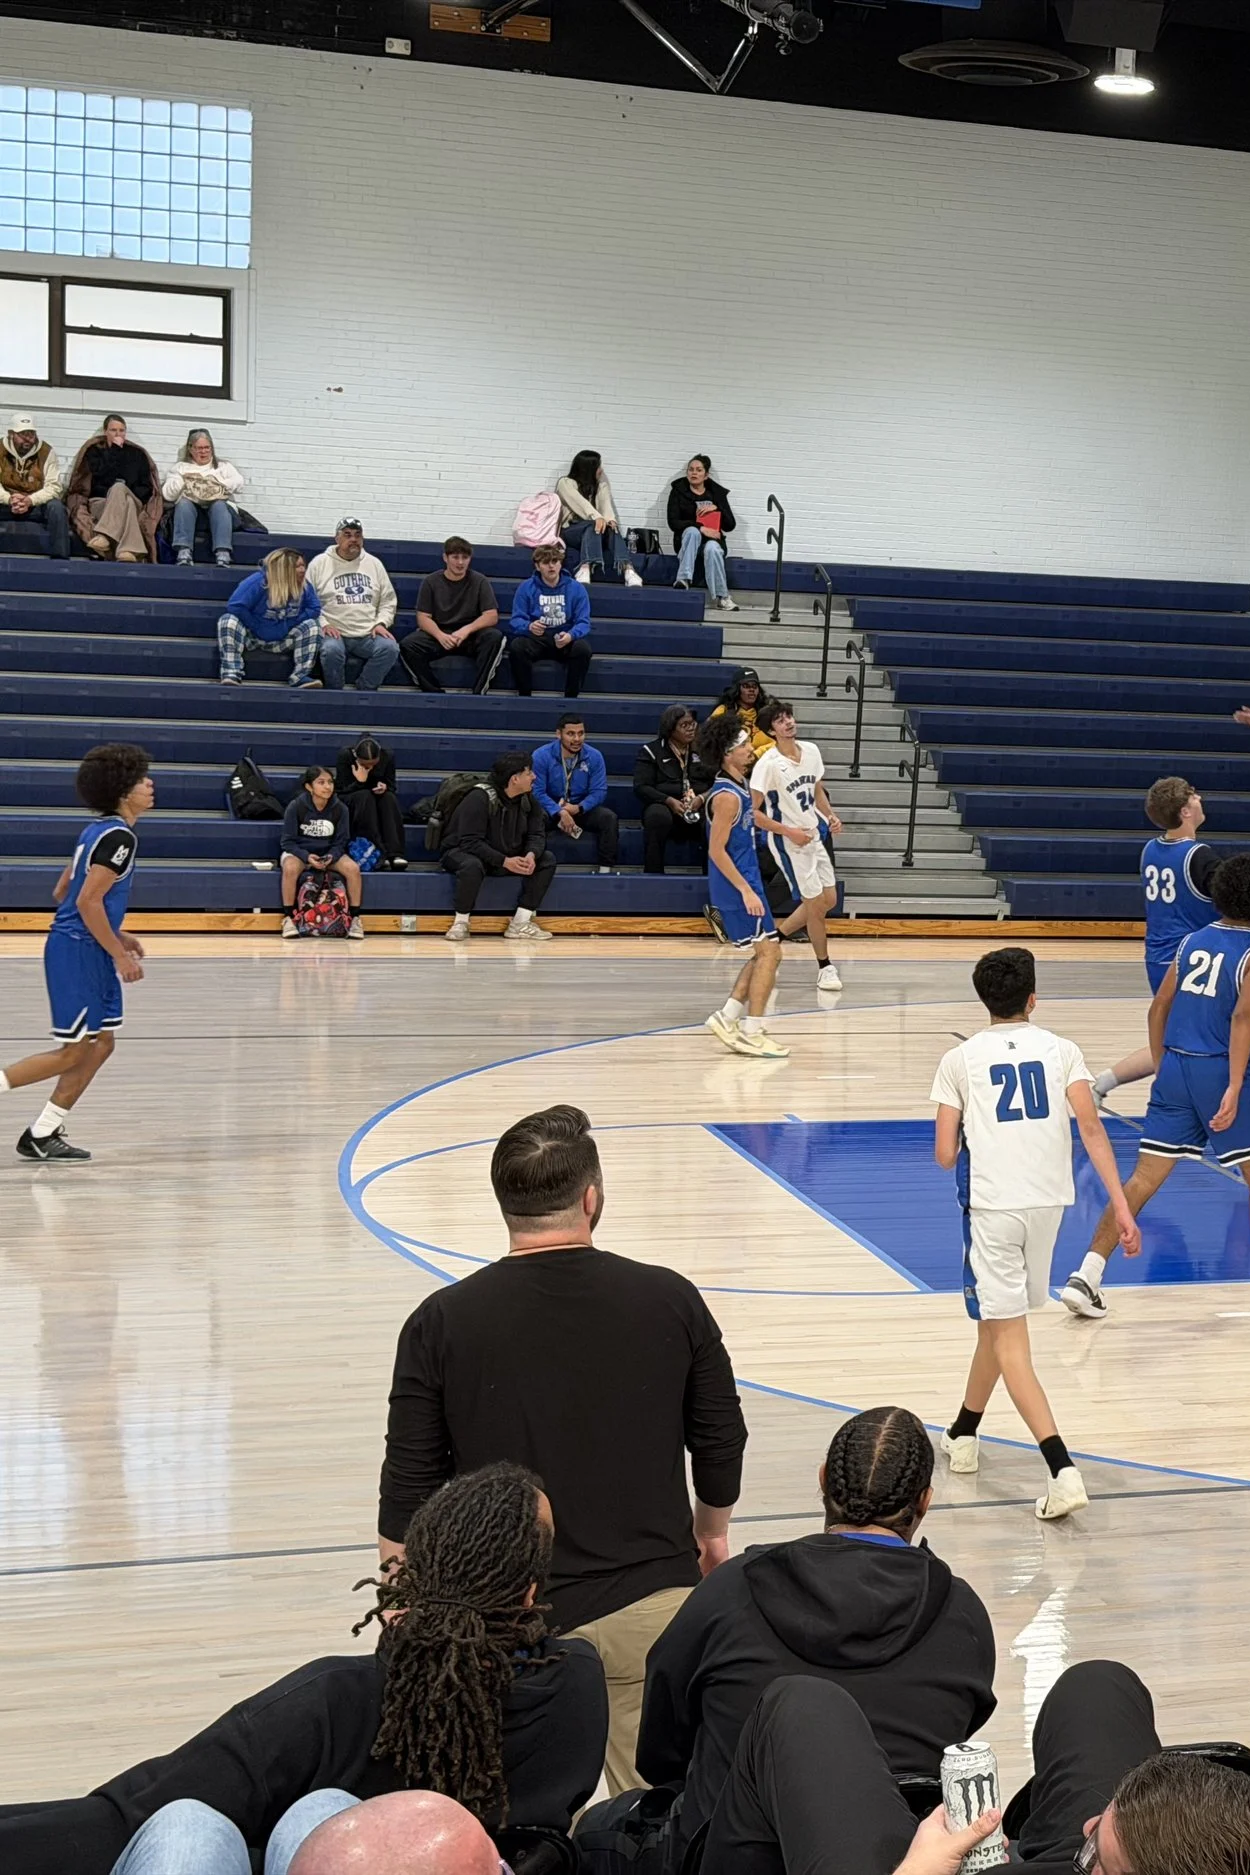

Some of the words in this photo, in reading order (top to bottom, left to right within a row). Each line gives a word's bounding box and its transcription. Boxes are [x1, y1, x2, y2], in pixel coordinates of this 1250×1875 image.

[333, 572, 373, 590] GUTHRIE
[1144, 864, 1177, 903] 33
[1180, 949, 1225, 998] 21
[989, 1060, 1050, 1122] 20
[963, 1842, 1004, 1859] ONSTE
